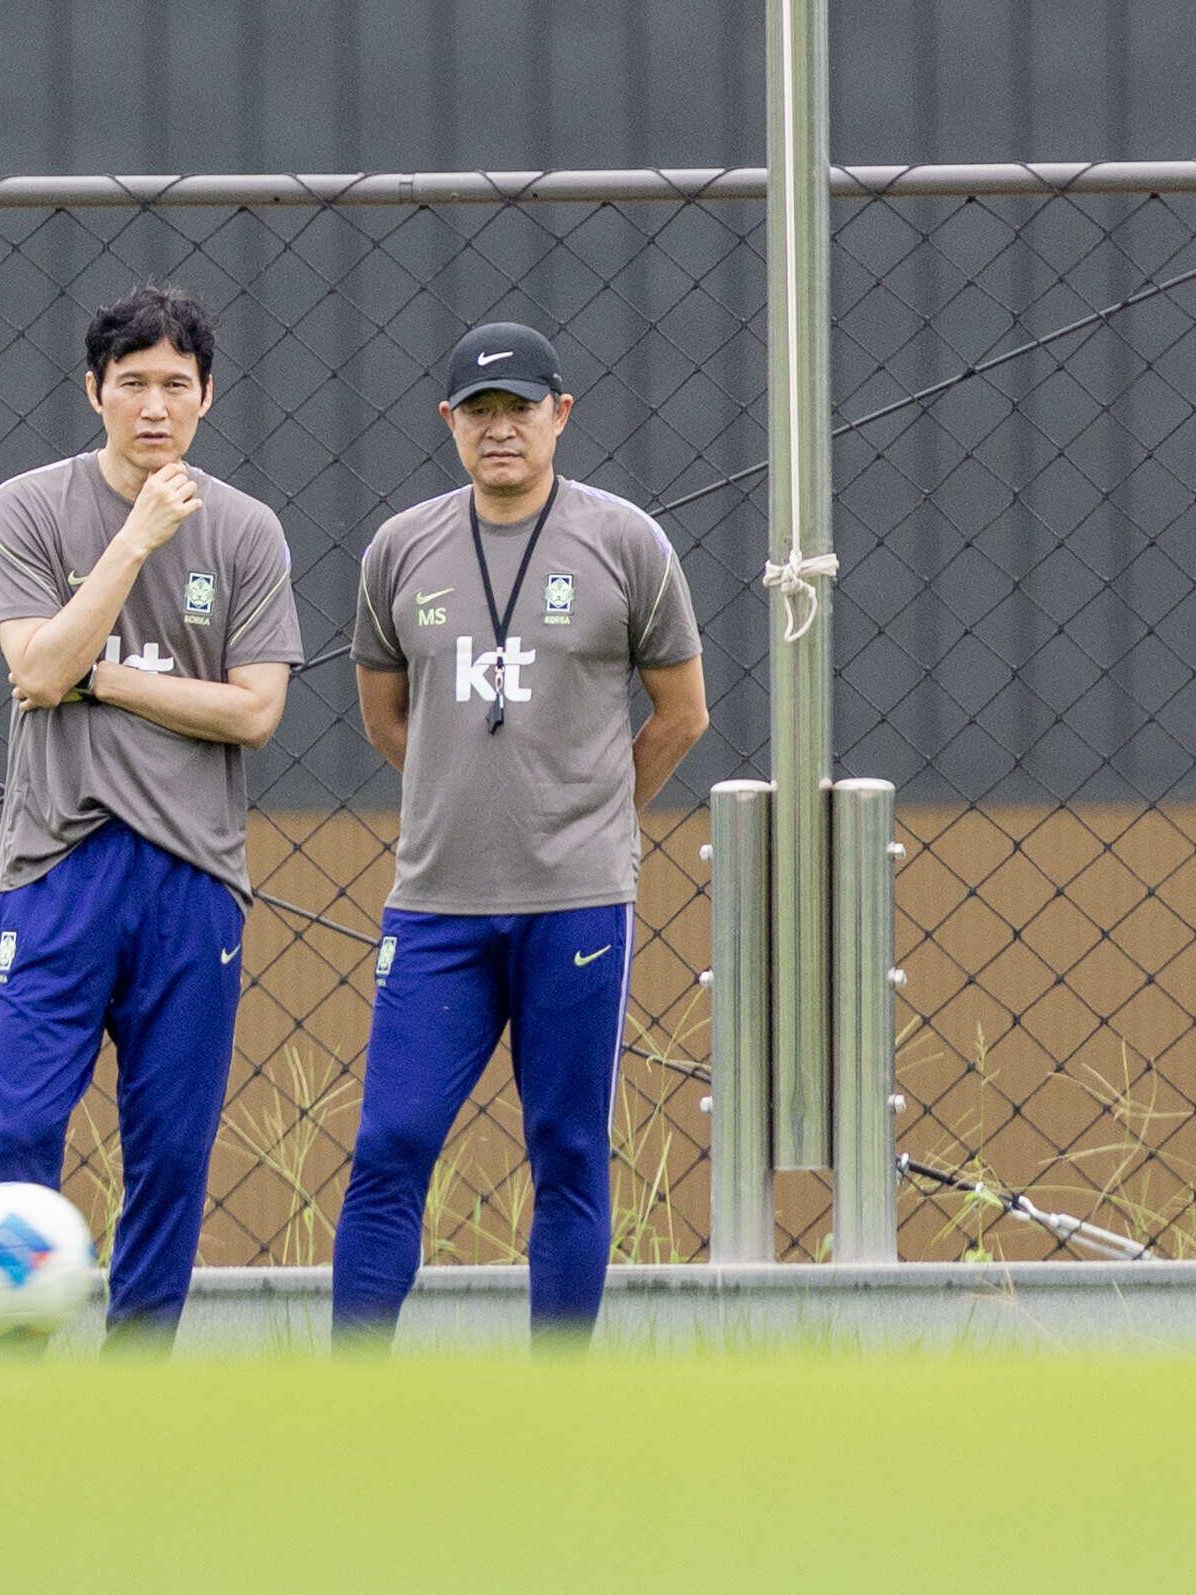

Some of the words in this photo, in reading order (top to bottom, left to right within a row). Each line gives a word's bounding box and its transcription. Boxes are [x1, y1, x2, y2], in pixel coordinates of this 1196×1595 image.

[418, 607, 447, 627] MS
[544, 615, 571, 625] KOREA
[456, 635, 536, 702] kt
